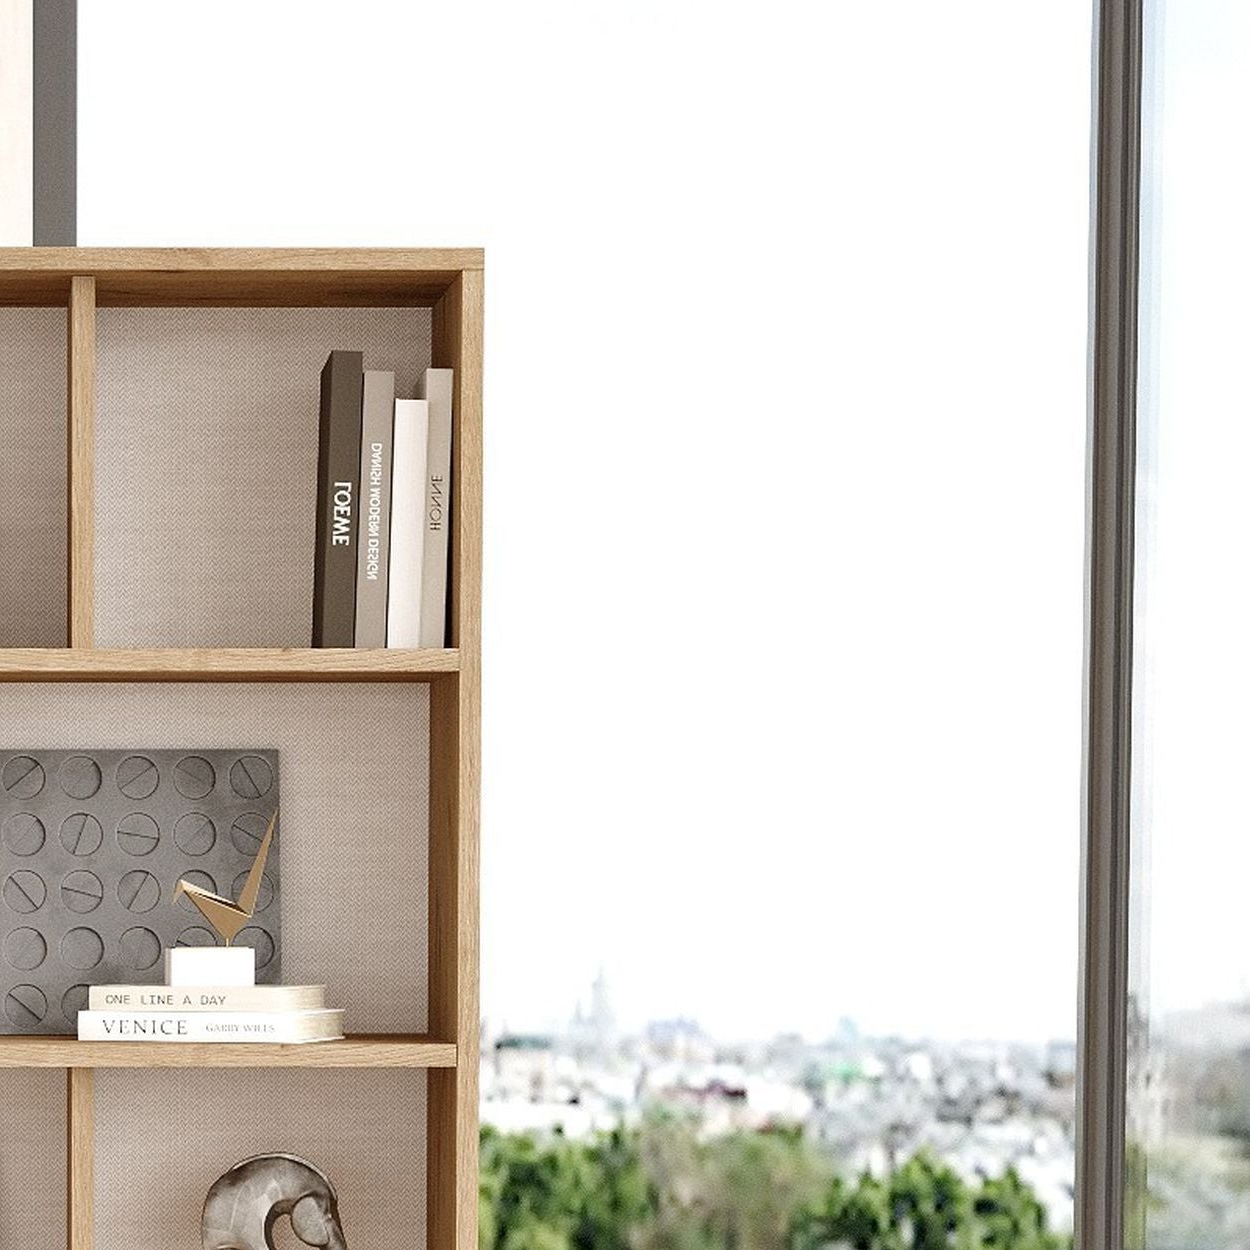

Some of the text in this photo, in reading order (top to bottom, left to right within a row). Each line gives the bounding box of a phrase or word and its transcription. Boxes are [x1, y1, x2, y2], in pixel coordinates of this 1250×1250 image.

[105, 994, 227, 1006] ONE LINE A DAY
[102, 1019, 189, 1036] VENICE
